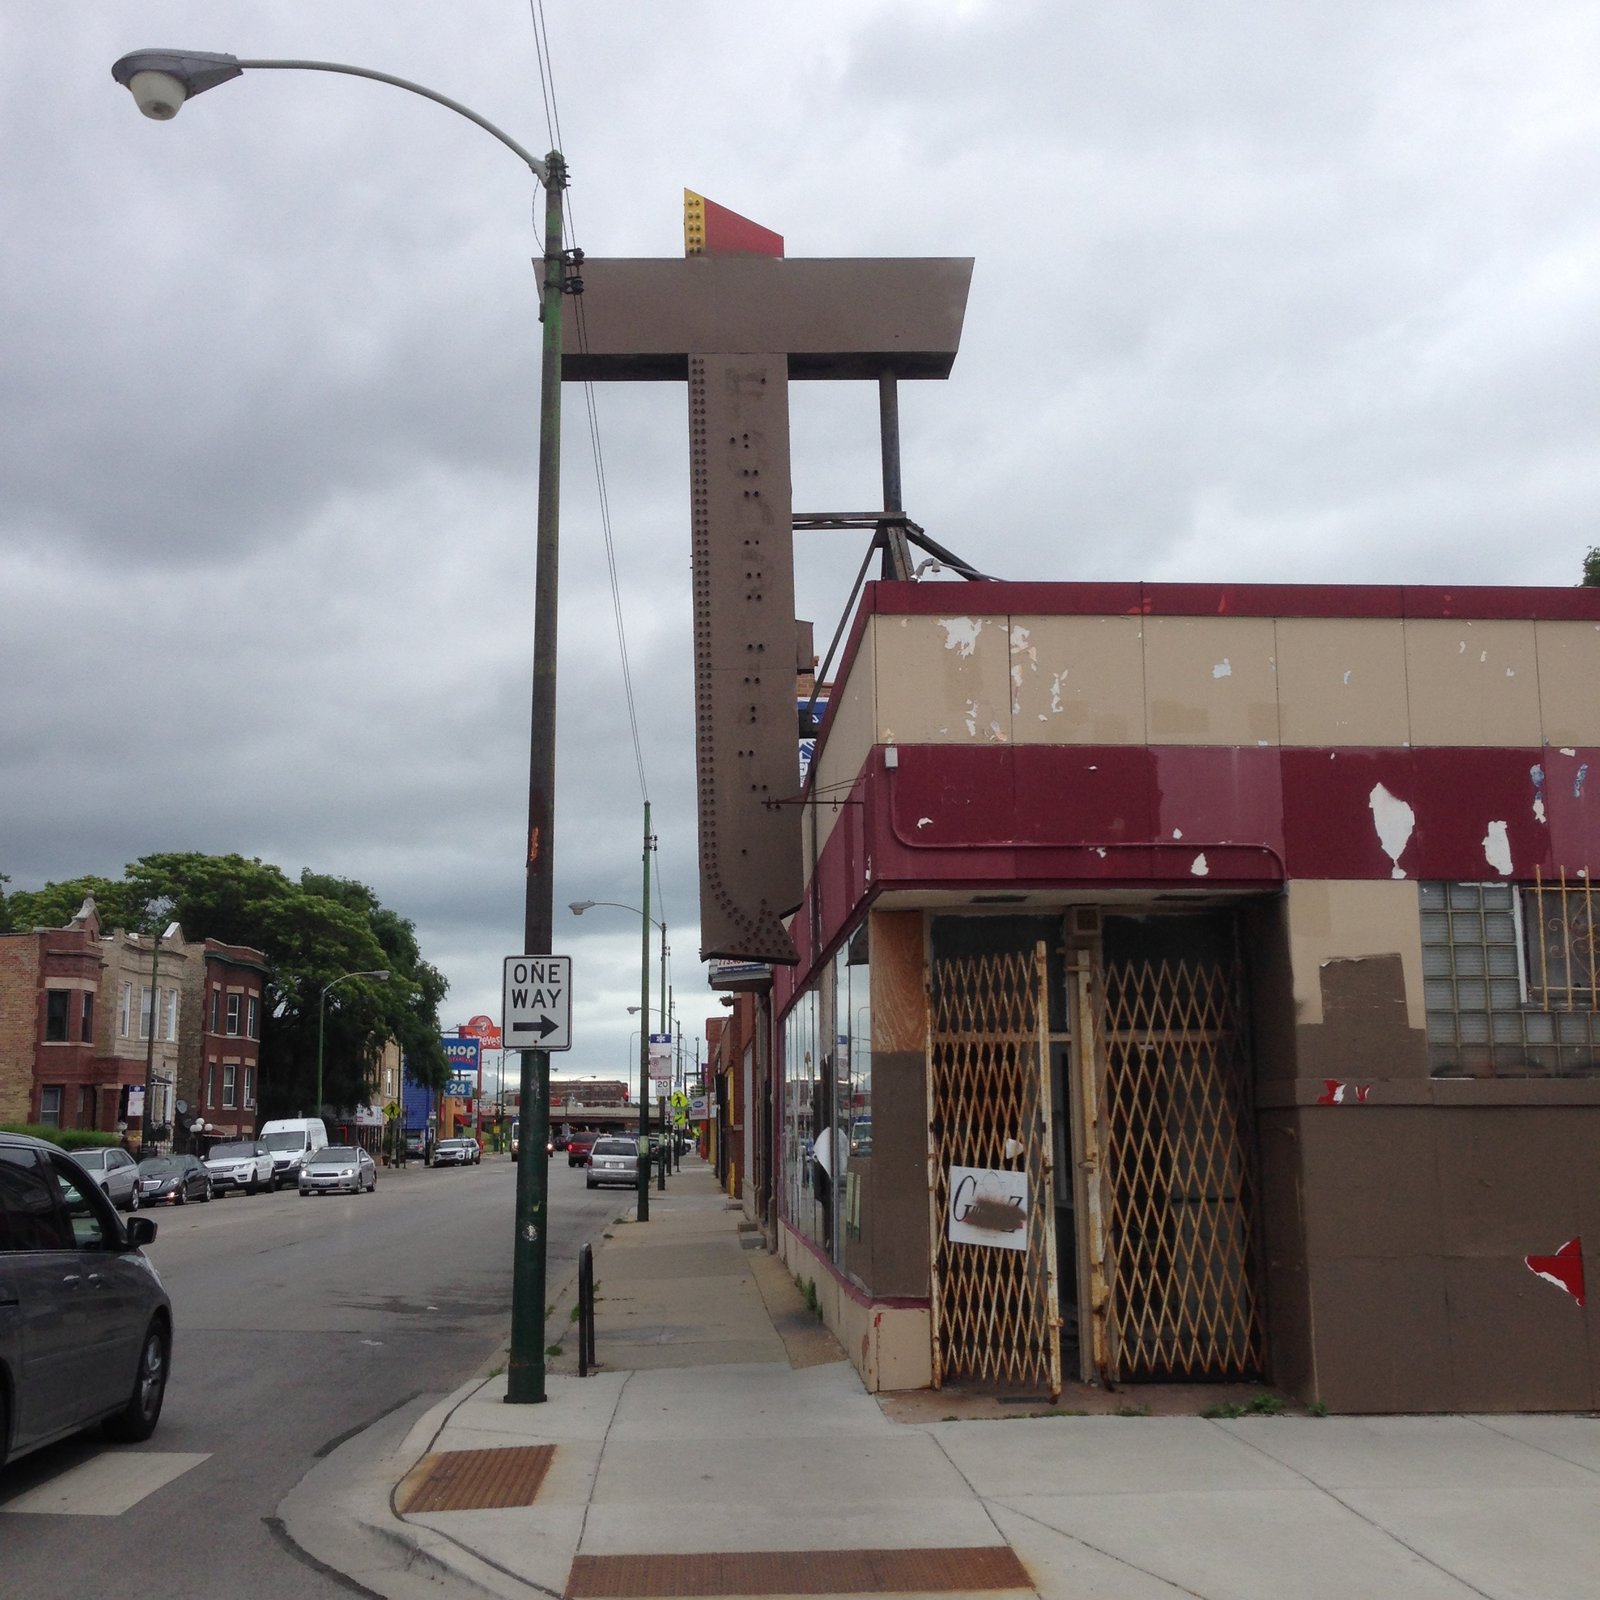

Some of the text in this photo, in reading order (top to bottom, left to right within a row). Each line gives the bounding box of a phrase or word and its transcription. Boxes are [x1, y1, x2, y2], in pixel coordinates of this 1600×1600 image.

[514, 964, 561, 984] ONE
[512, 989, 562, 1009] WAY
[450, 1083, 466, 1095] 24
[657, 1080, 669, 1088] 20
